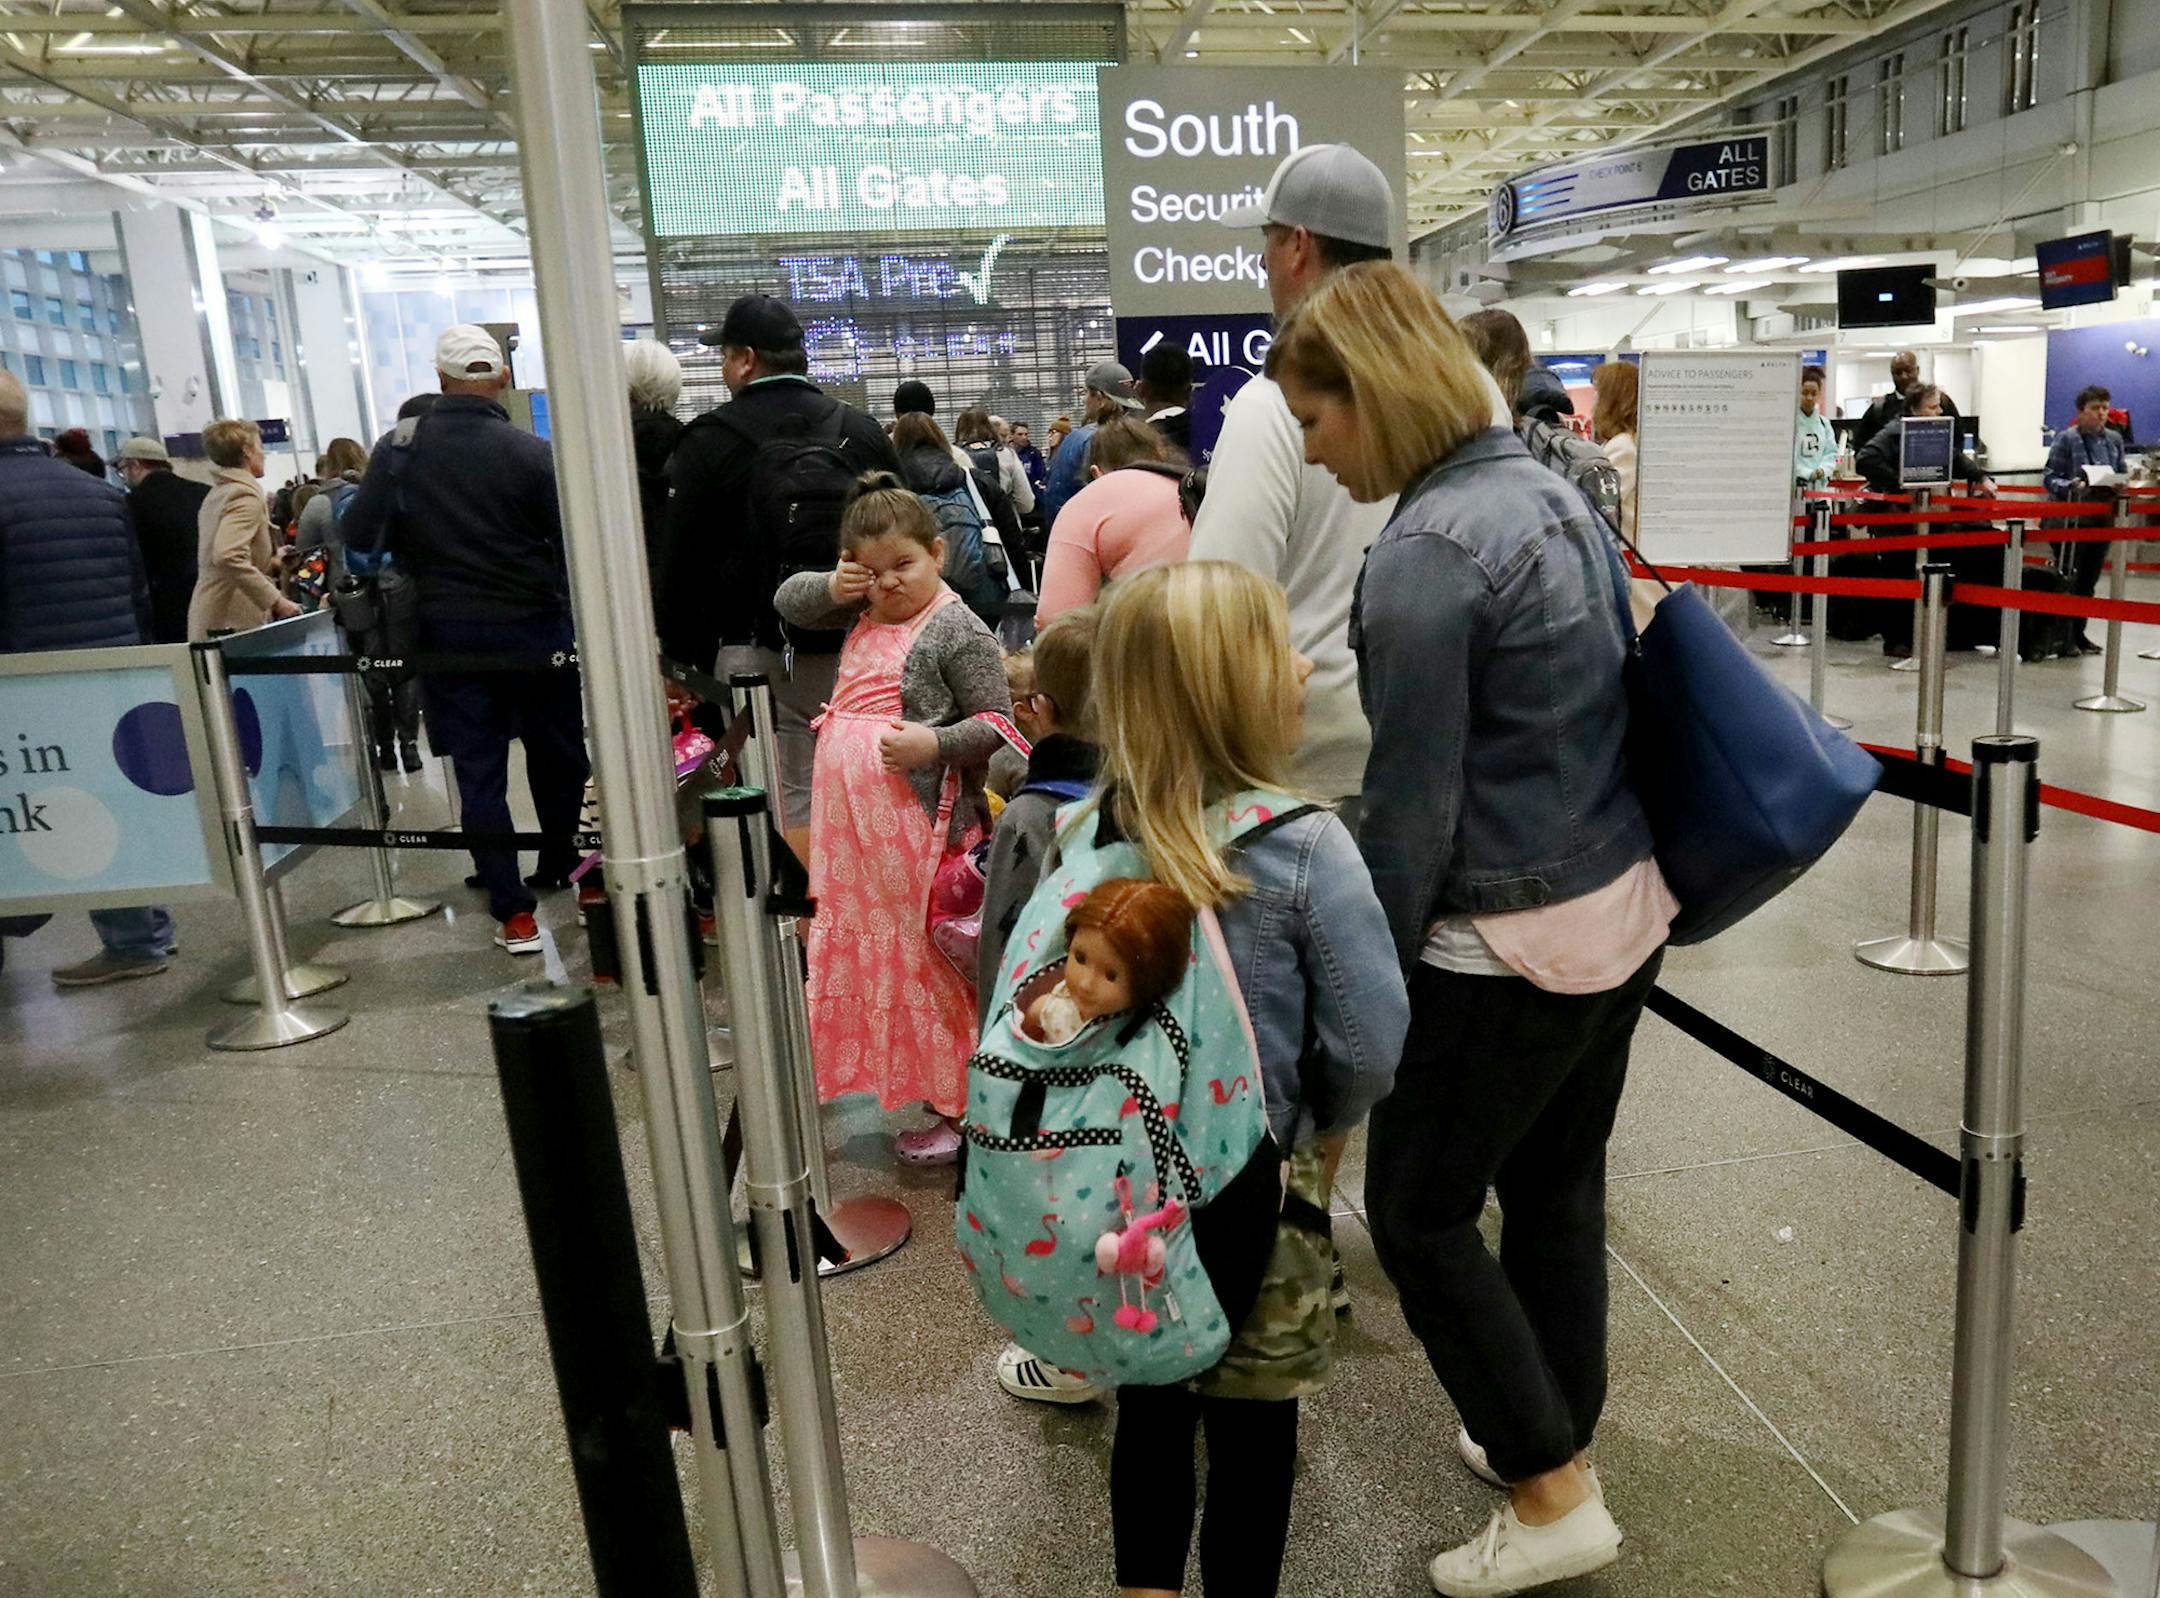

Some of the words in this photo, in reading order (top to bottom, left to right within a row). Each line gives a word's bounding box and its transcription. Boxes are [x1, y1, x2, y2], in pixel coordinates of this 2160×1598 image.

[689, 82, 754, 129] All
[771, 81, 1080, 135] Passengers
[1125, 99, 1299, 158] South
[1719, 142, 1759, 165] ALL
[778, 165, 840, 211] All
[857, 163, 1009, 209] Gates
[1687, 166, 1760, 192] GATES
[779, 256, 870, 301] TSA
[880, 255, 958, 300] Pre
[1187, 331, 1231, 366] All
[1648, 369, 1681, 379] ADVICE
[1684, 369, 1696, 379] TO
[1698, 369, 1753, 380] PASSENGERS
[373, 659, 404, 668] CLEAR
[18, 733, 71, 773] in
[399, 835, 428, 843] CLEAR
[1780, 1070, 1814, 1099] CLEAR
